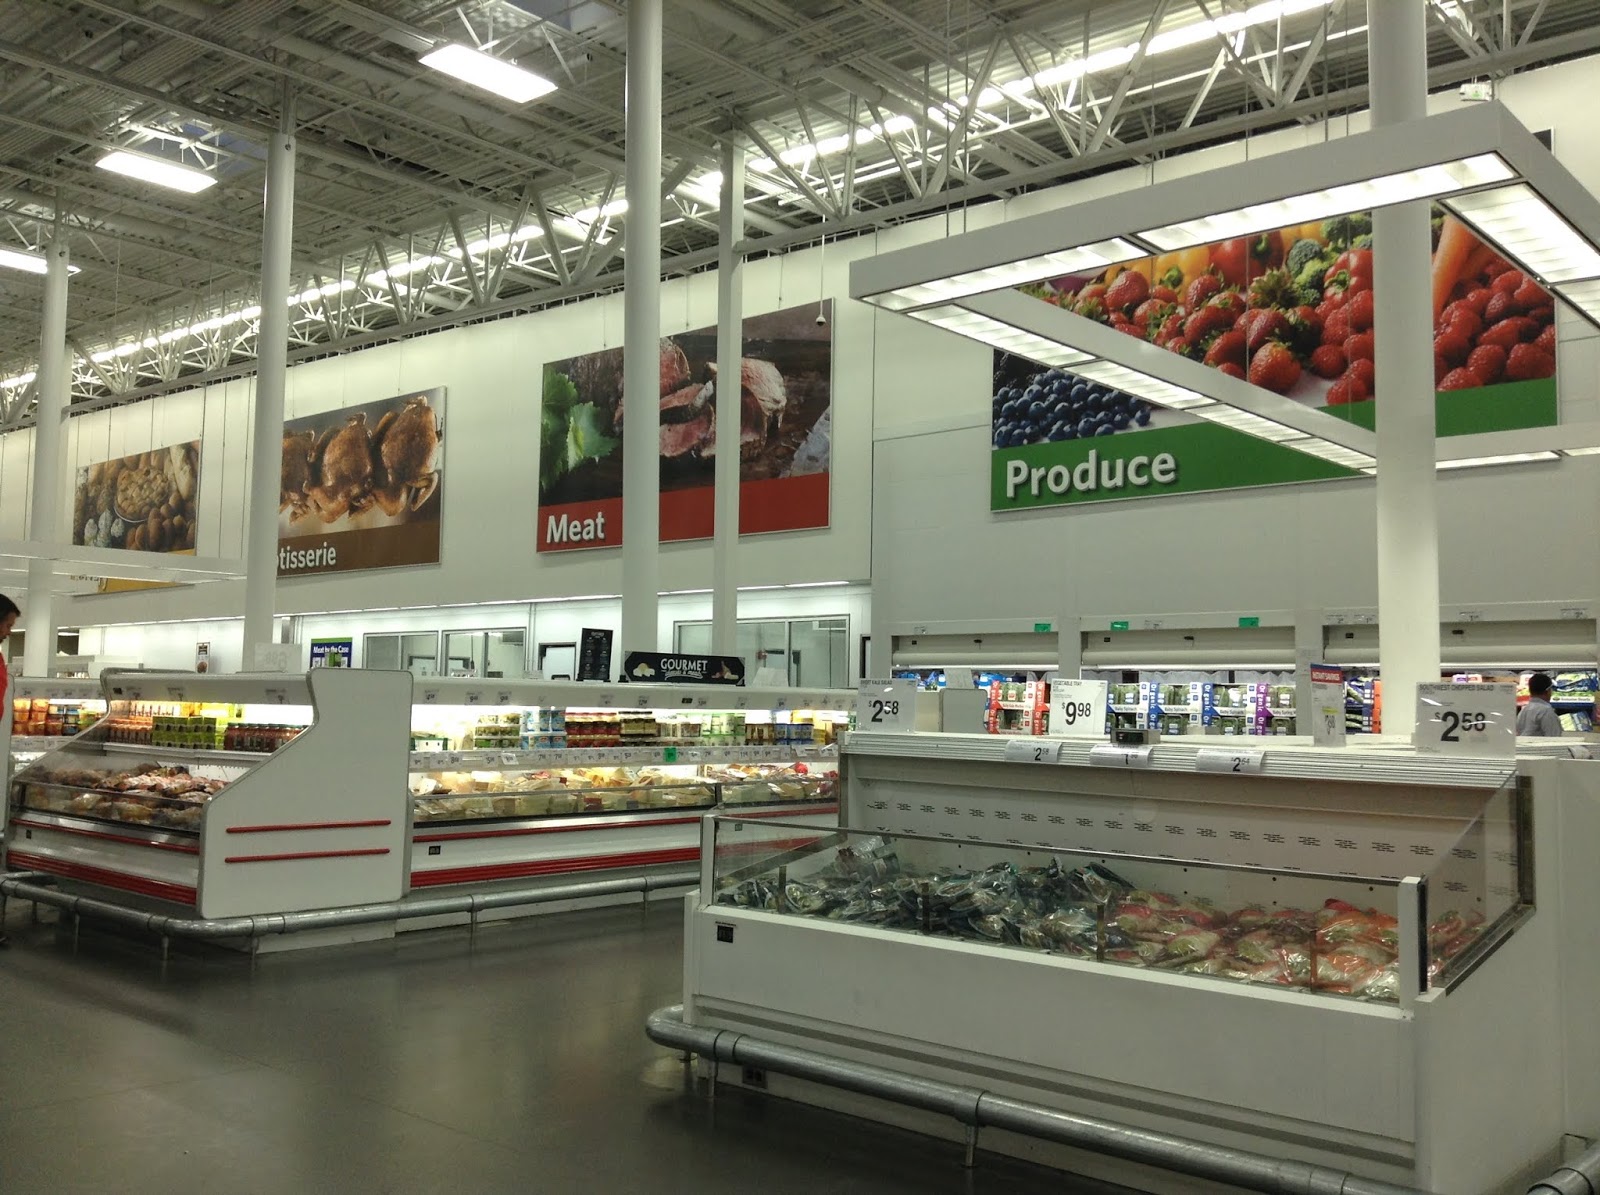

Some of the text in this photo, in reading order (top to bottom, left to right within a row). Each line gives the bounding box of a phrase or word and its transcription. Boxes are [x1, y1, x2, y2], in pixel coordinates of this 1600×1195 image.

[1006, 449, 1177, 498] Produce
[546, 511, 605, 543] Meat
[277, 541, 337, 570] tisserie
[660, 658, 708, 671] GOURMET
